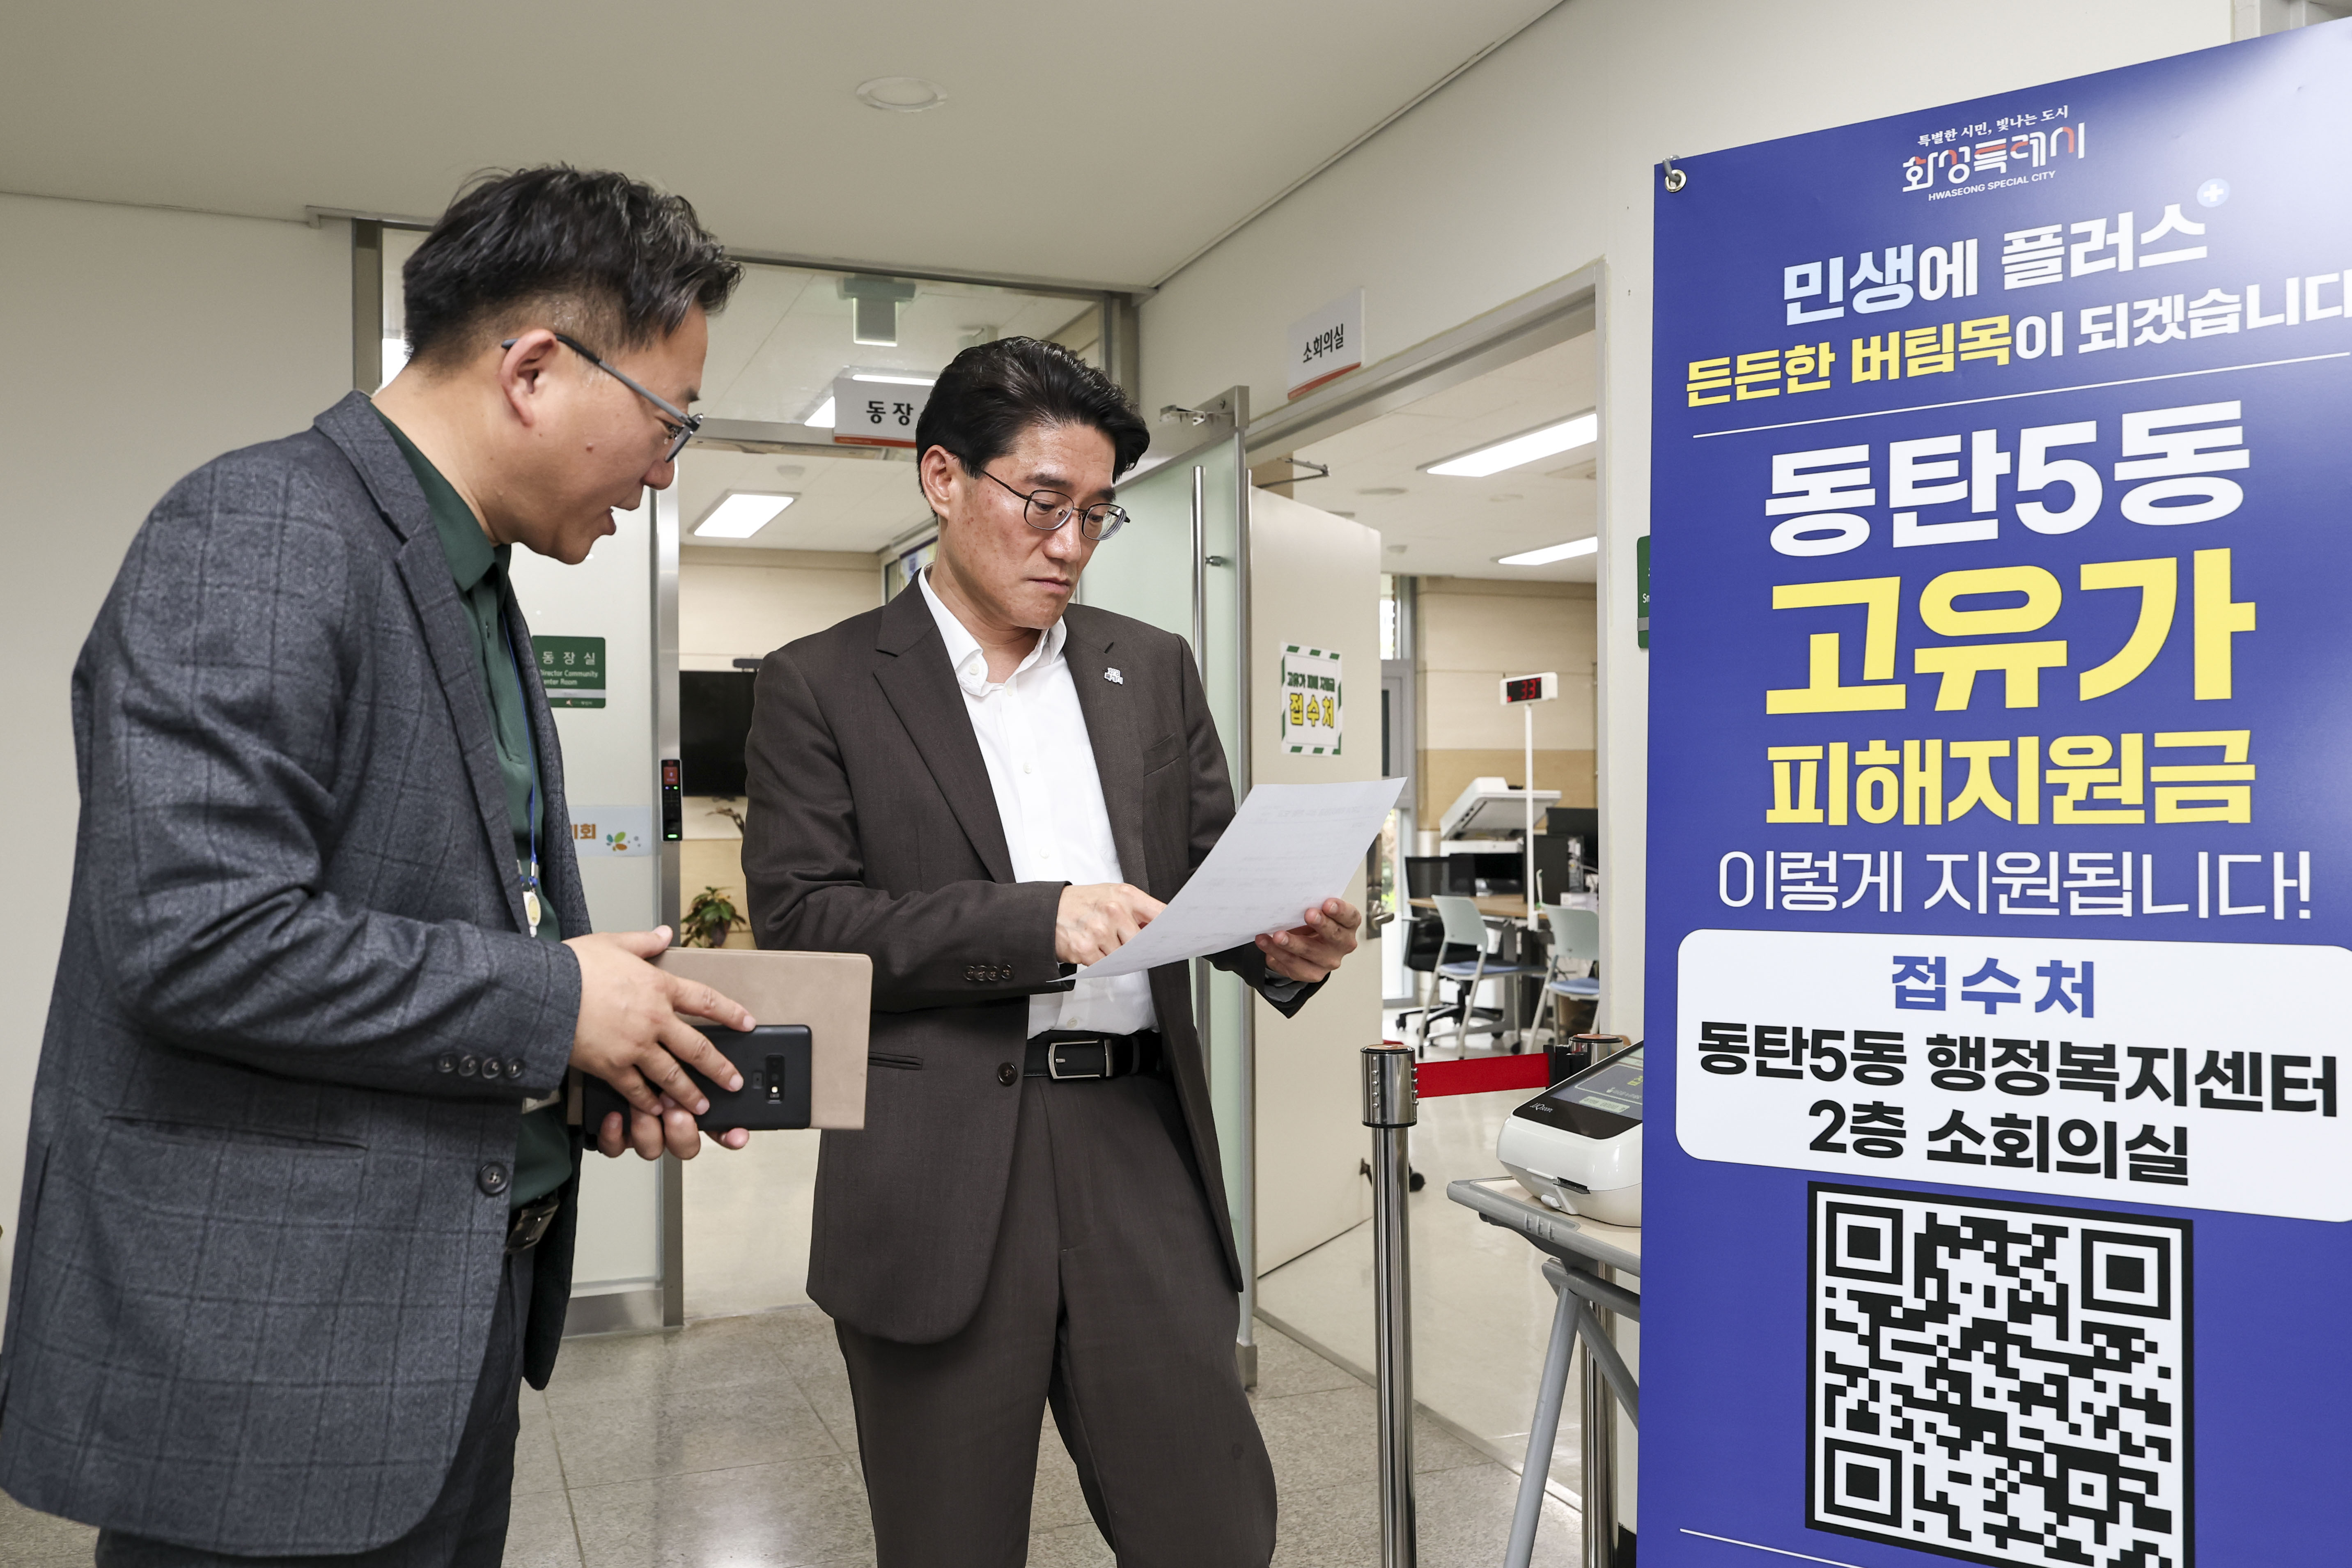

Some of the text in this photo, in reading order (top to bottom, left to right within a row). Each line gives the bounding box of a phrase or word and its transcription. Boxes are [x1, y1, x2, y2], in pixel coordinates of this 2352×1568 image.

[1902, 122, 2086, 193] 화성특례시
[1917, 105, 2068, 147] 특별한 시민, 빛나는 도시
[1928, 170, 2056, 201] HWASEONG SPECIAL CITY
[1783, 203, 2208, 326] 민생에 플러스
[1303, 323, 1344, 363] 소회의실
[1686, 269, 2352, 408] 든든한 버팀목이 되겠습니다
[1765, 400, 2251, 557] 동탄5동
[1765, 547, 2256, 715] 고유가
[564, 670, 598, 678] Community
[1290, 693, 1334, 729] 접수처
[1766, 729, 2256, 826] 피해지원금
[1719, 850, 2311, 920] 이렇게 지원됩니다!
[1892, 955, 2094, 1018] 접수처
[1698, 1021, 2337, 1118] 동탄5동 행정복지센터
[1808, 1099, 2189, 1186] 2층 소회의실
